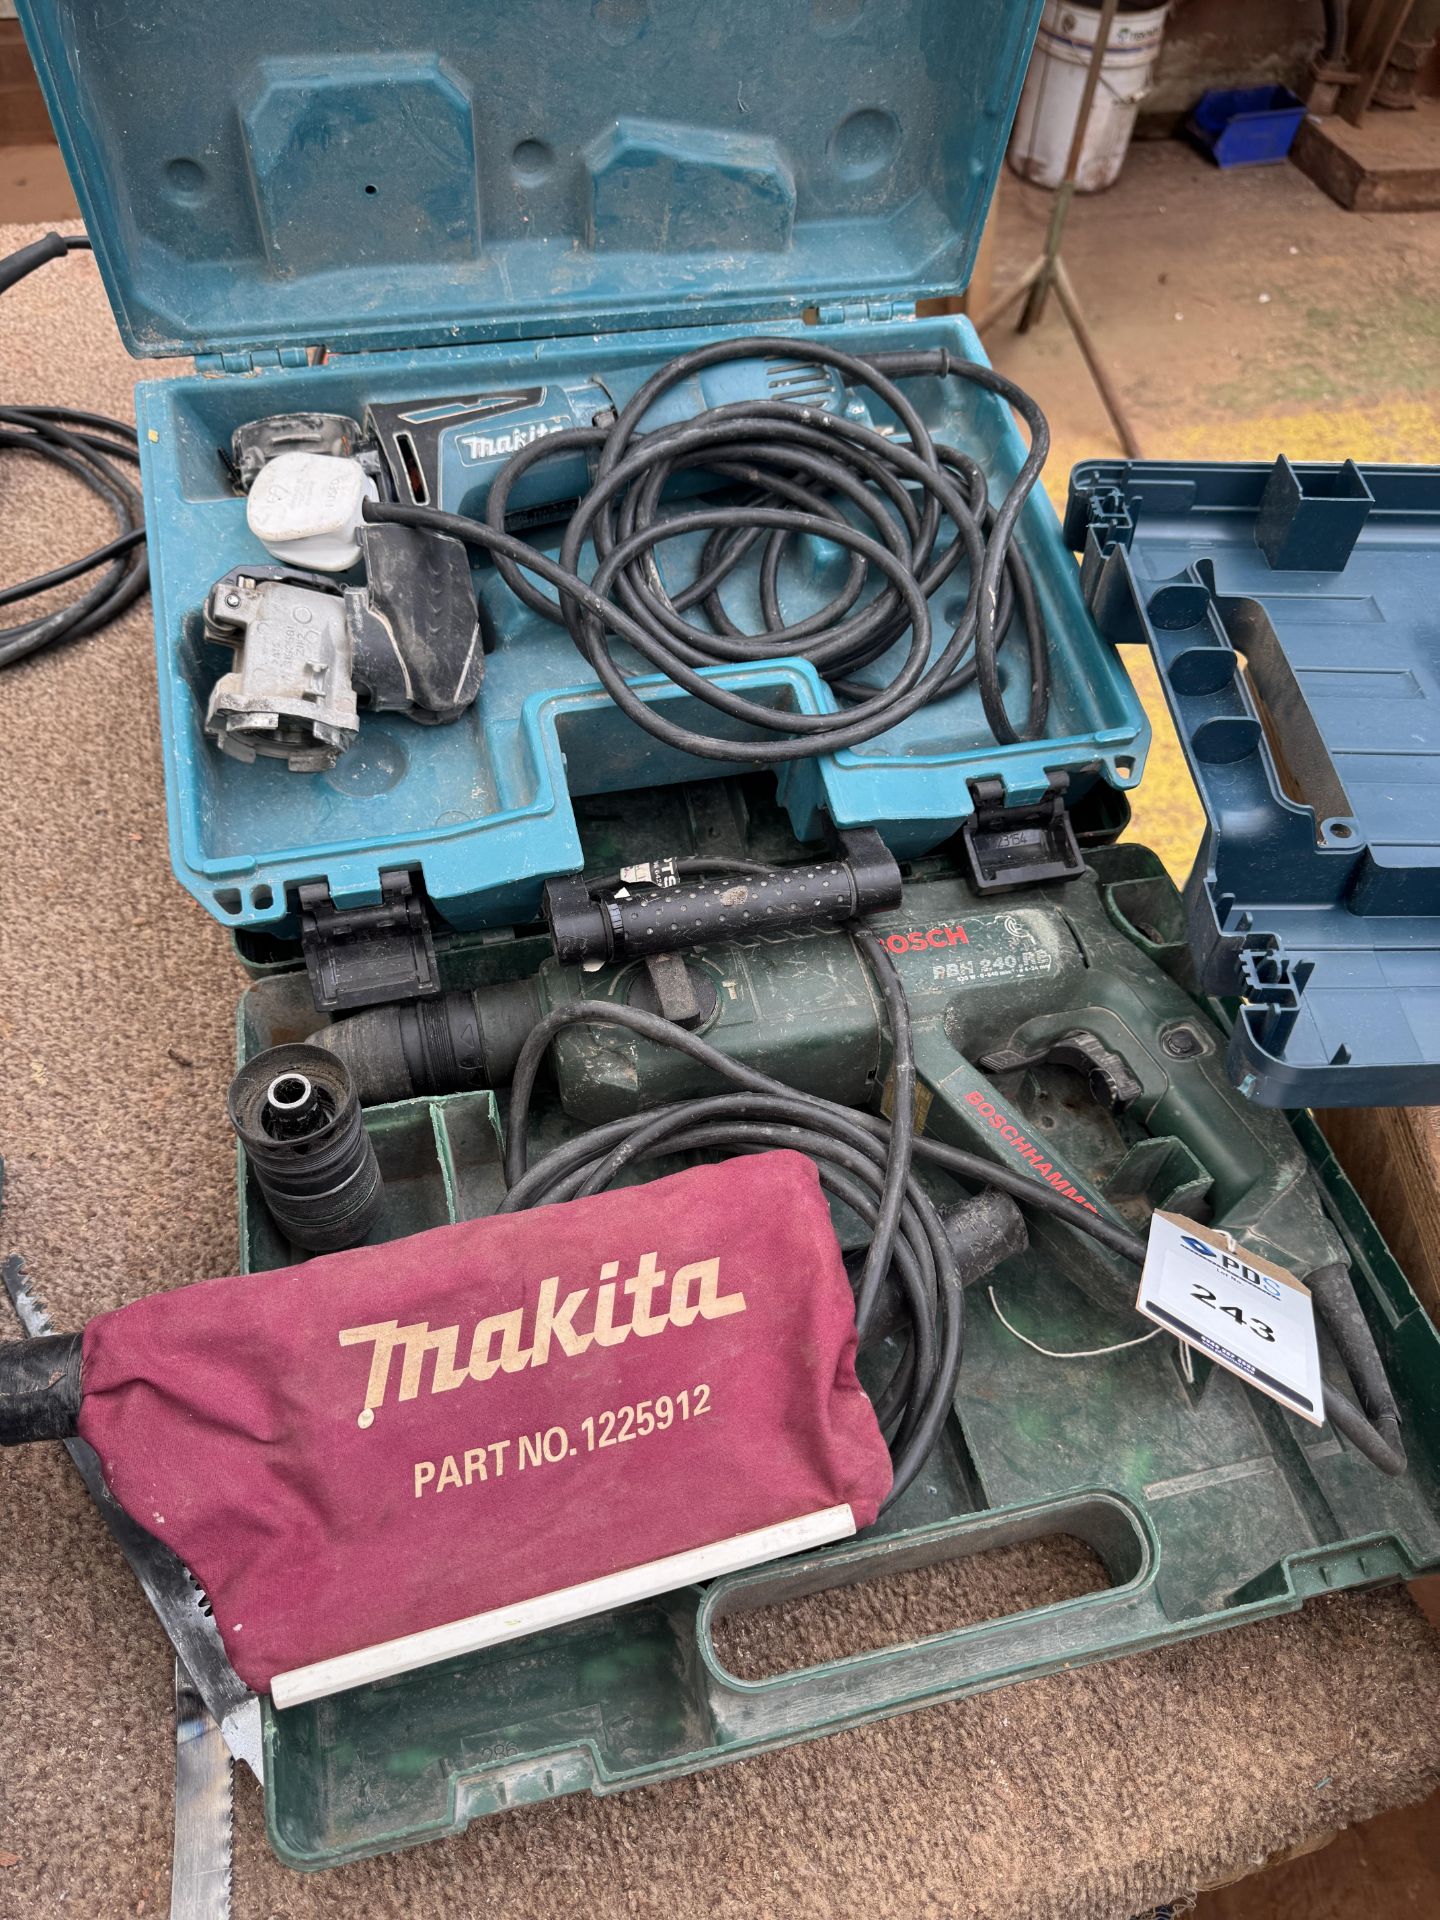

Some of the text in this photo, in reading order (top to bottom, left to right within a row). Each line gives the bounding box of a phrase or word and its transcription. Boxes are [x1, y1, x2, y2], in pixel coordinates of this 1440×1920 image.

[932, 950, 1050, 980] PBH 240 RE
[1222, 1254, 1281, 1297] PDS
[1190, 1283, 1276, 1343] 243
[414, 1383, 712, 1499] PART NO. 1225912
